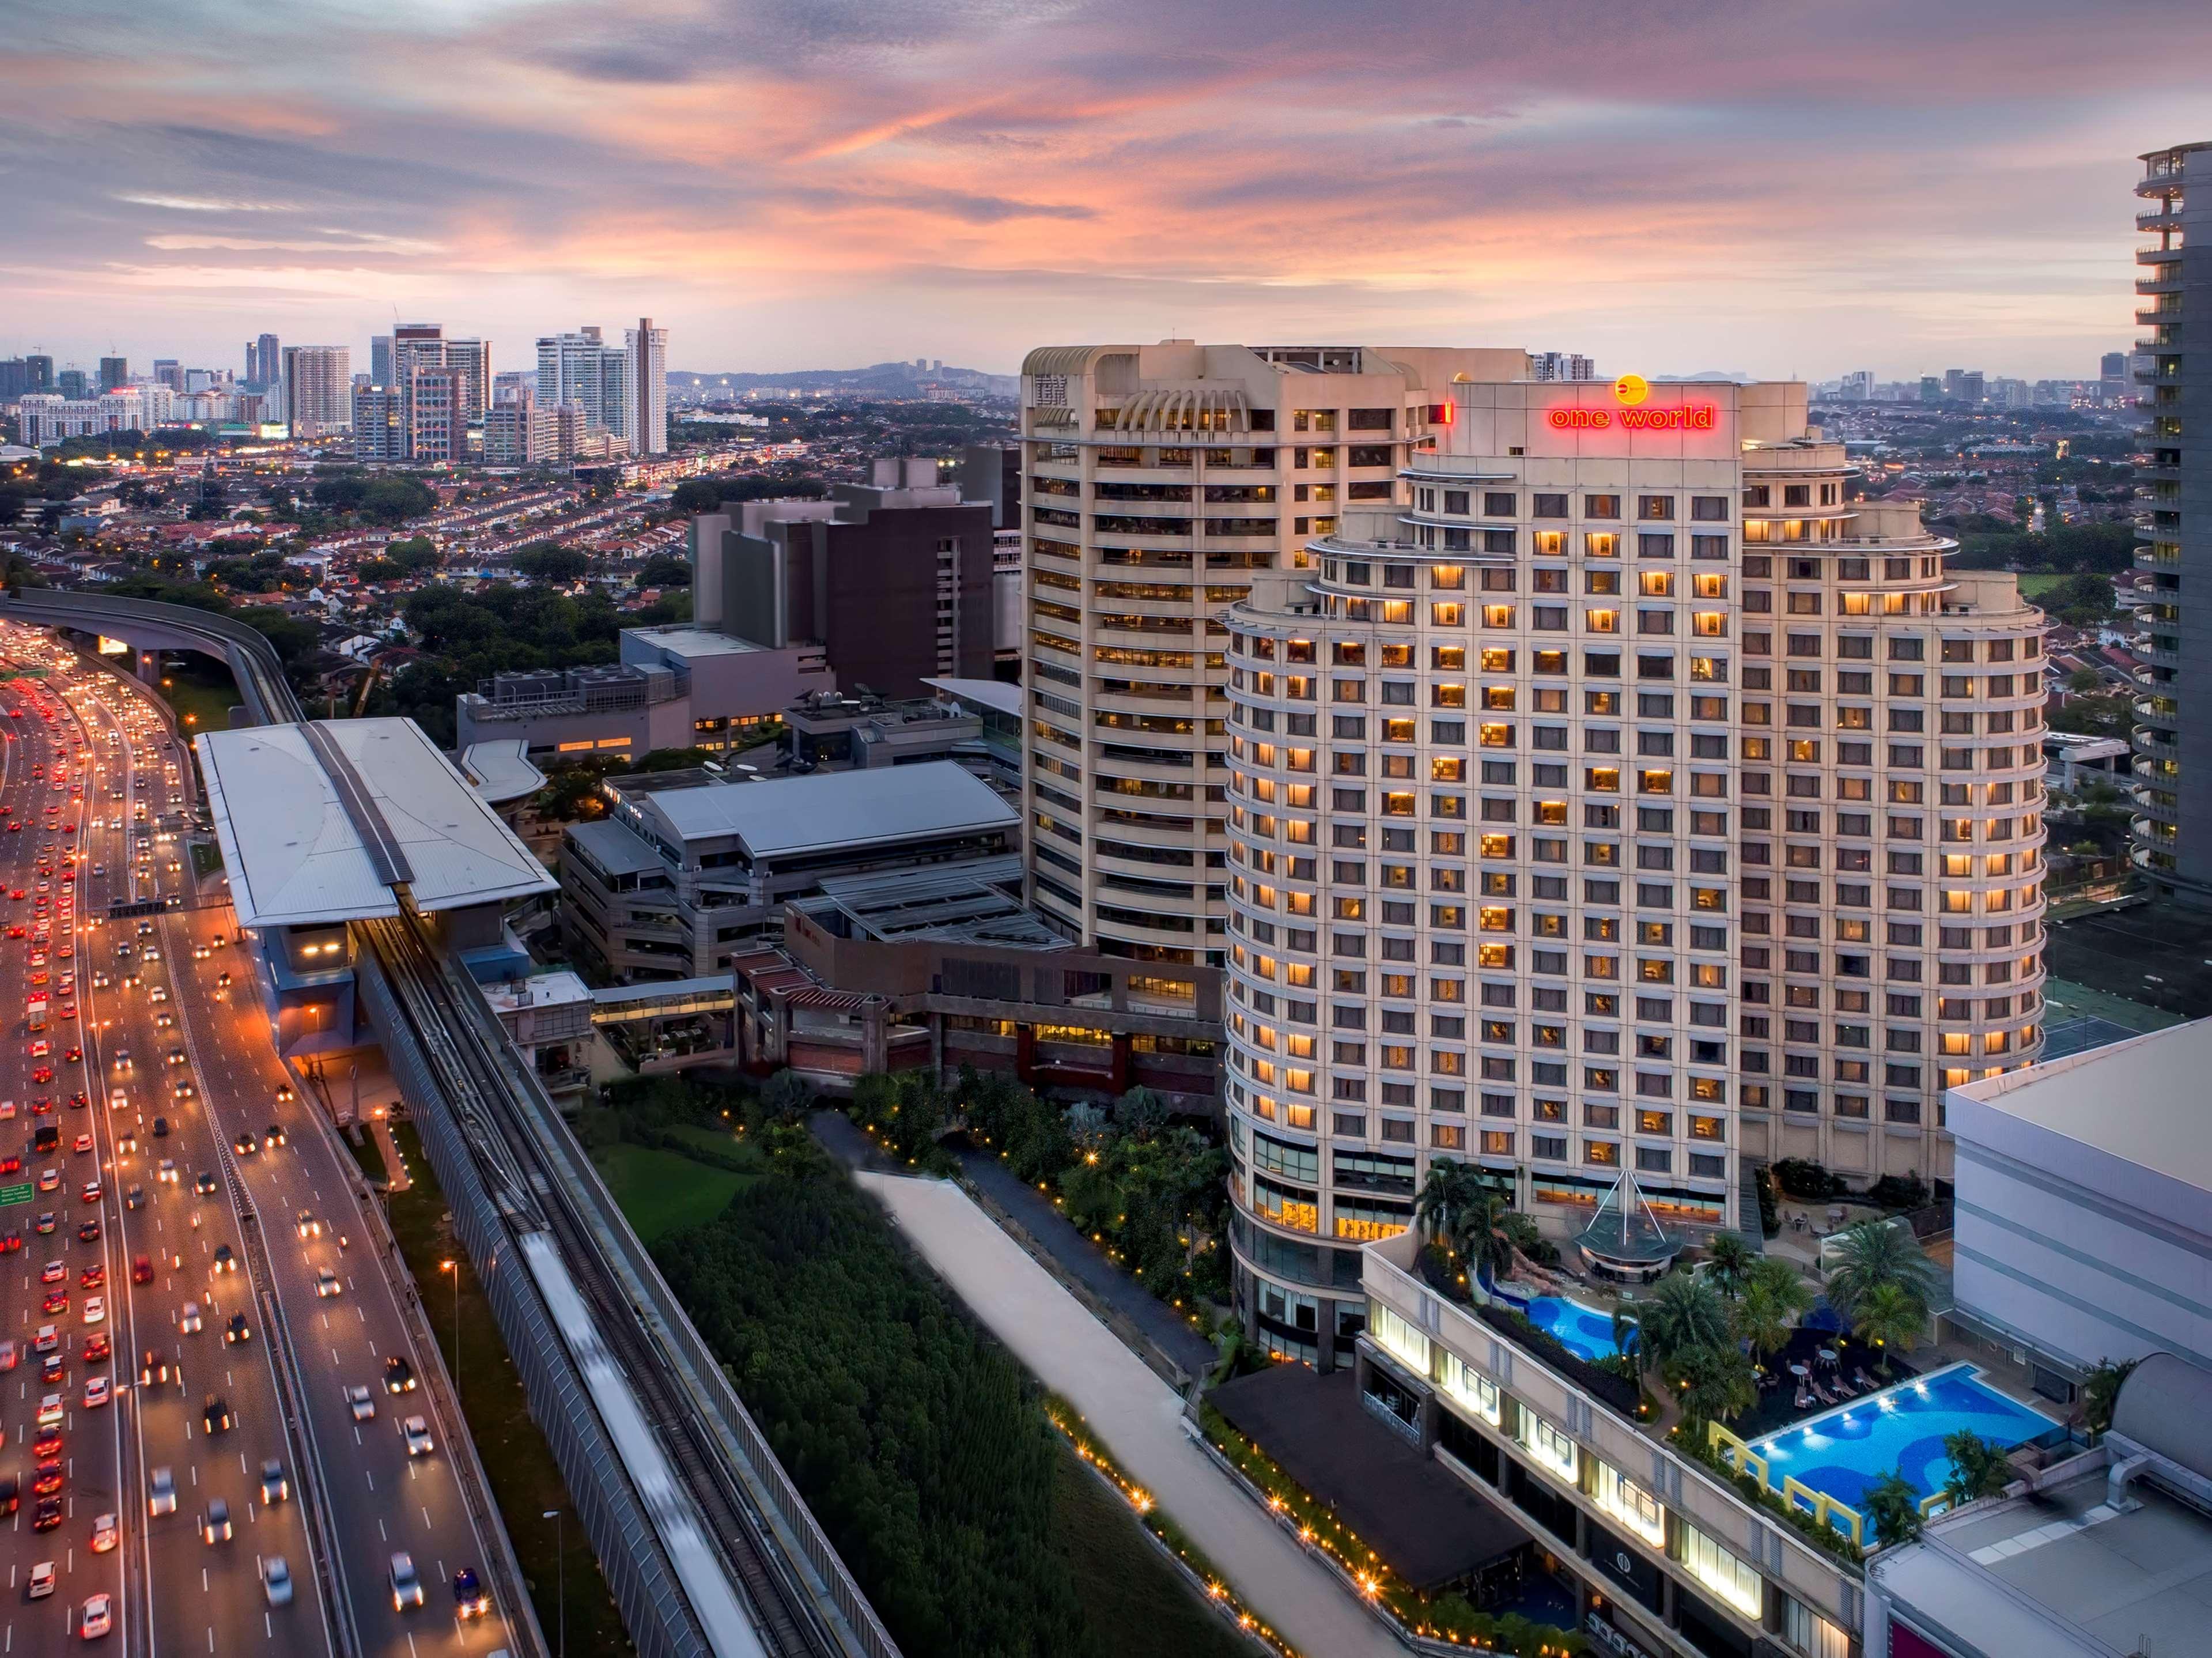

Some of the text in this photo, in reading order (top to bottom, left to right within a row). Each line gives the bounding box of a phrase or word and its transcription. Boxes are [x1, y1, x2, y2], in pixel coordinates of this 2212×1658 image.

[1035, 377, 1067, 405] IBM
[1550, 405, 1713, 428] one world
